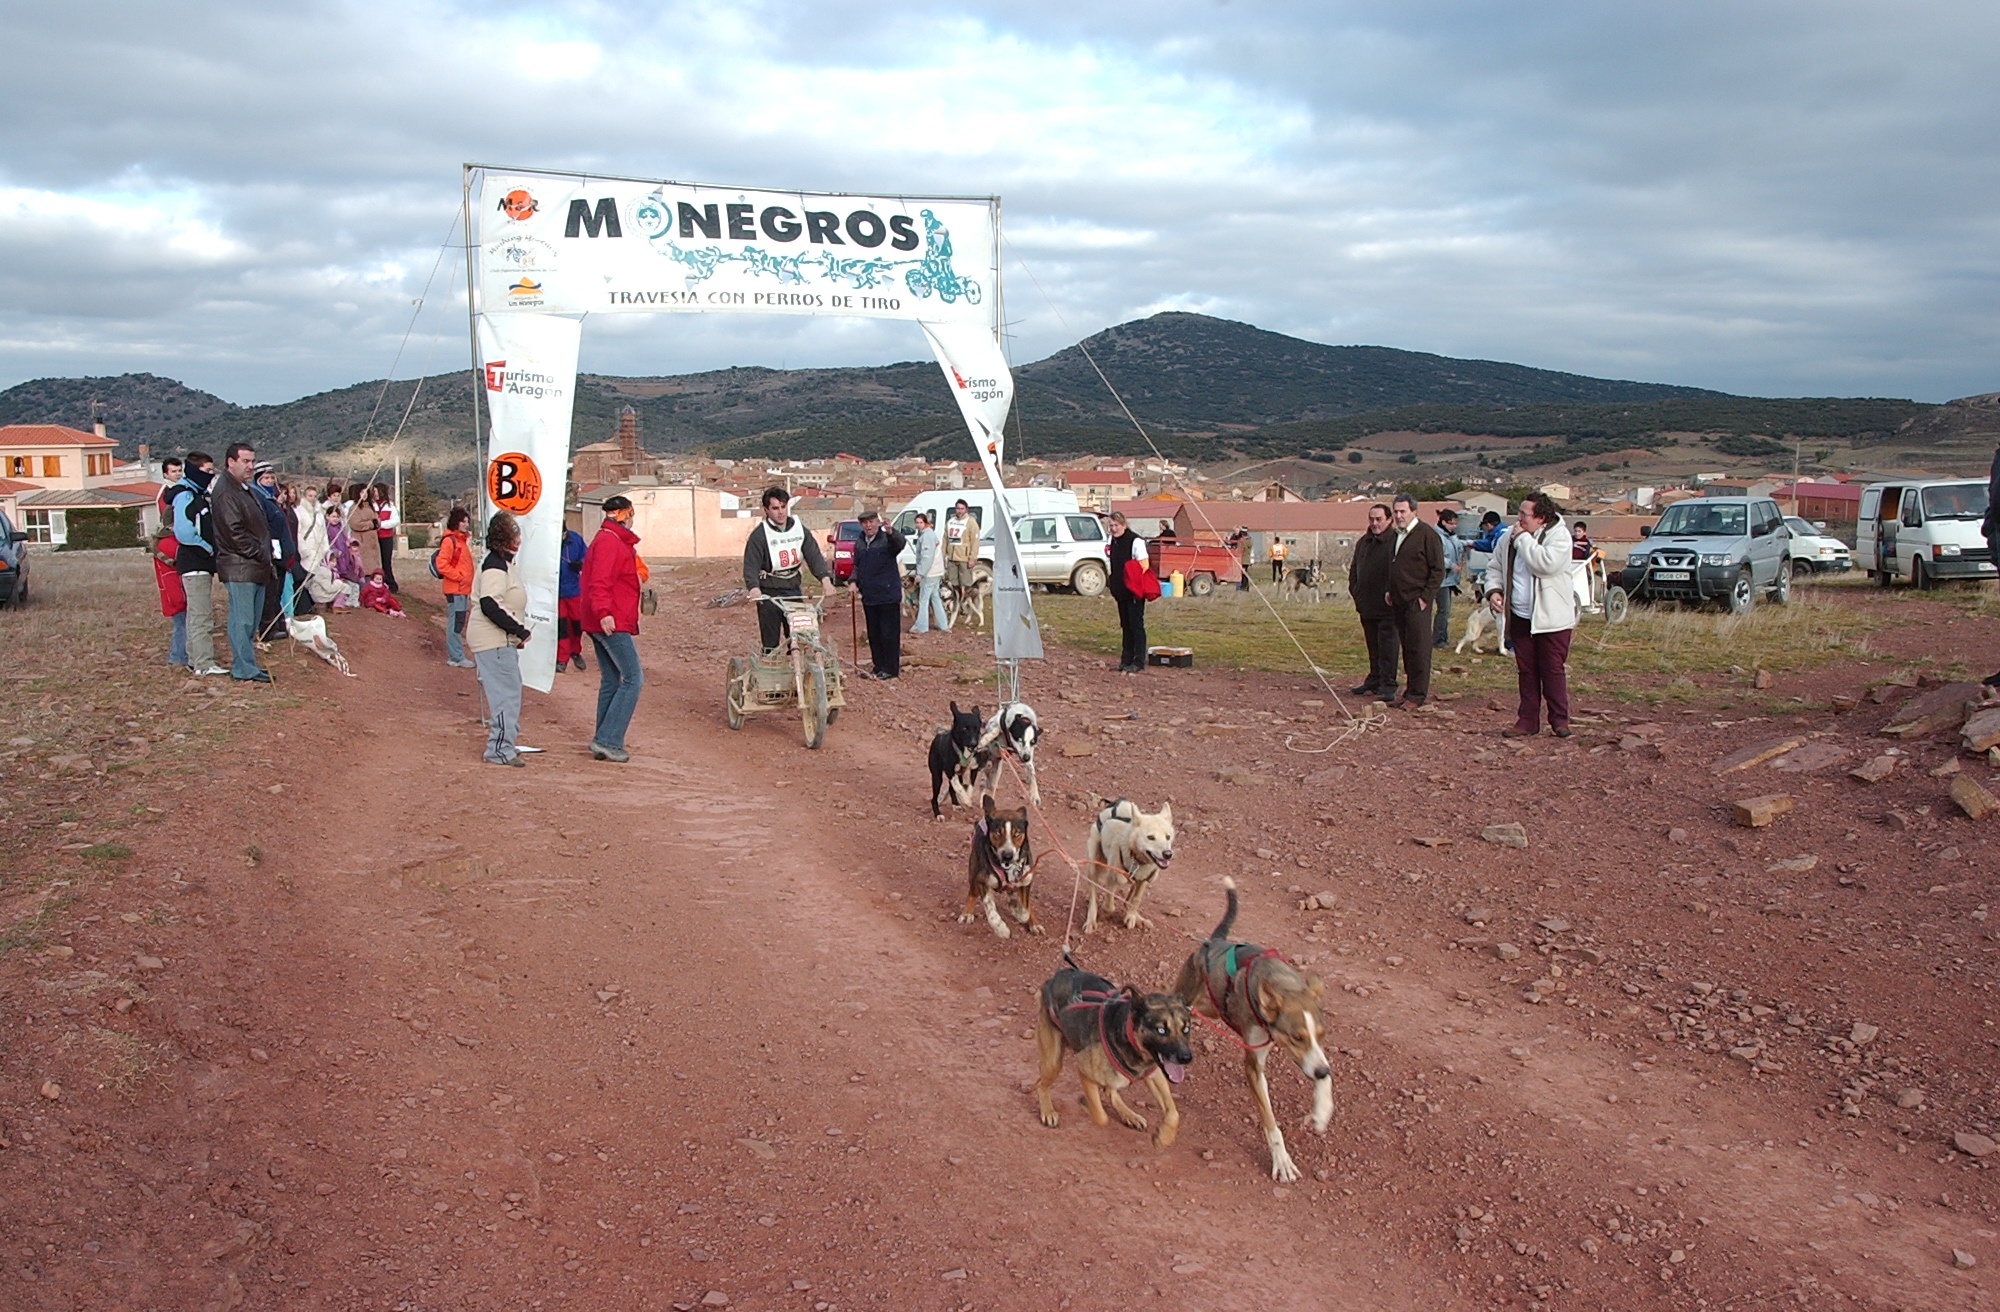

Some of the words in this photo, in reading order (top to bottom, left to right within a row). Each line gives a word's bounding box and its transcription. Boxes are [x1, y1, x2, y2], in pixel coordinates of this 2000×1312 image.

[564, 197, 920, 251] MONEGROS
[708, 291, 745, 304] CON
[754, 292, 823, 307] PERROS
[832, 295, 853, 308] DE
[860, 296, 901, 311] TIRO
[489, 364, 554, 386] Turismo
[508, 381, 563, 400] Aragón
[778, 548, 800, 568] 81
